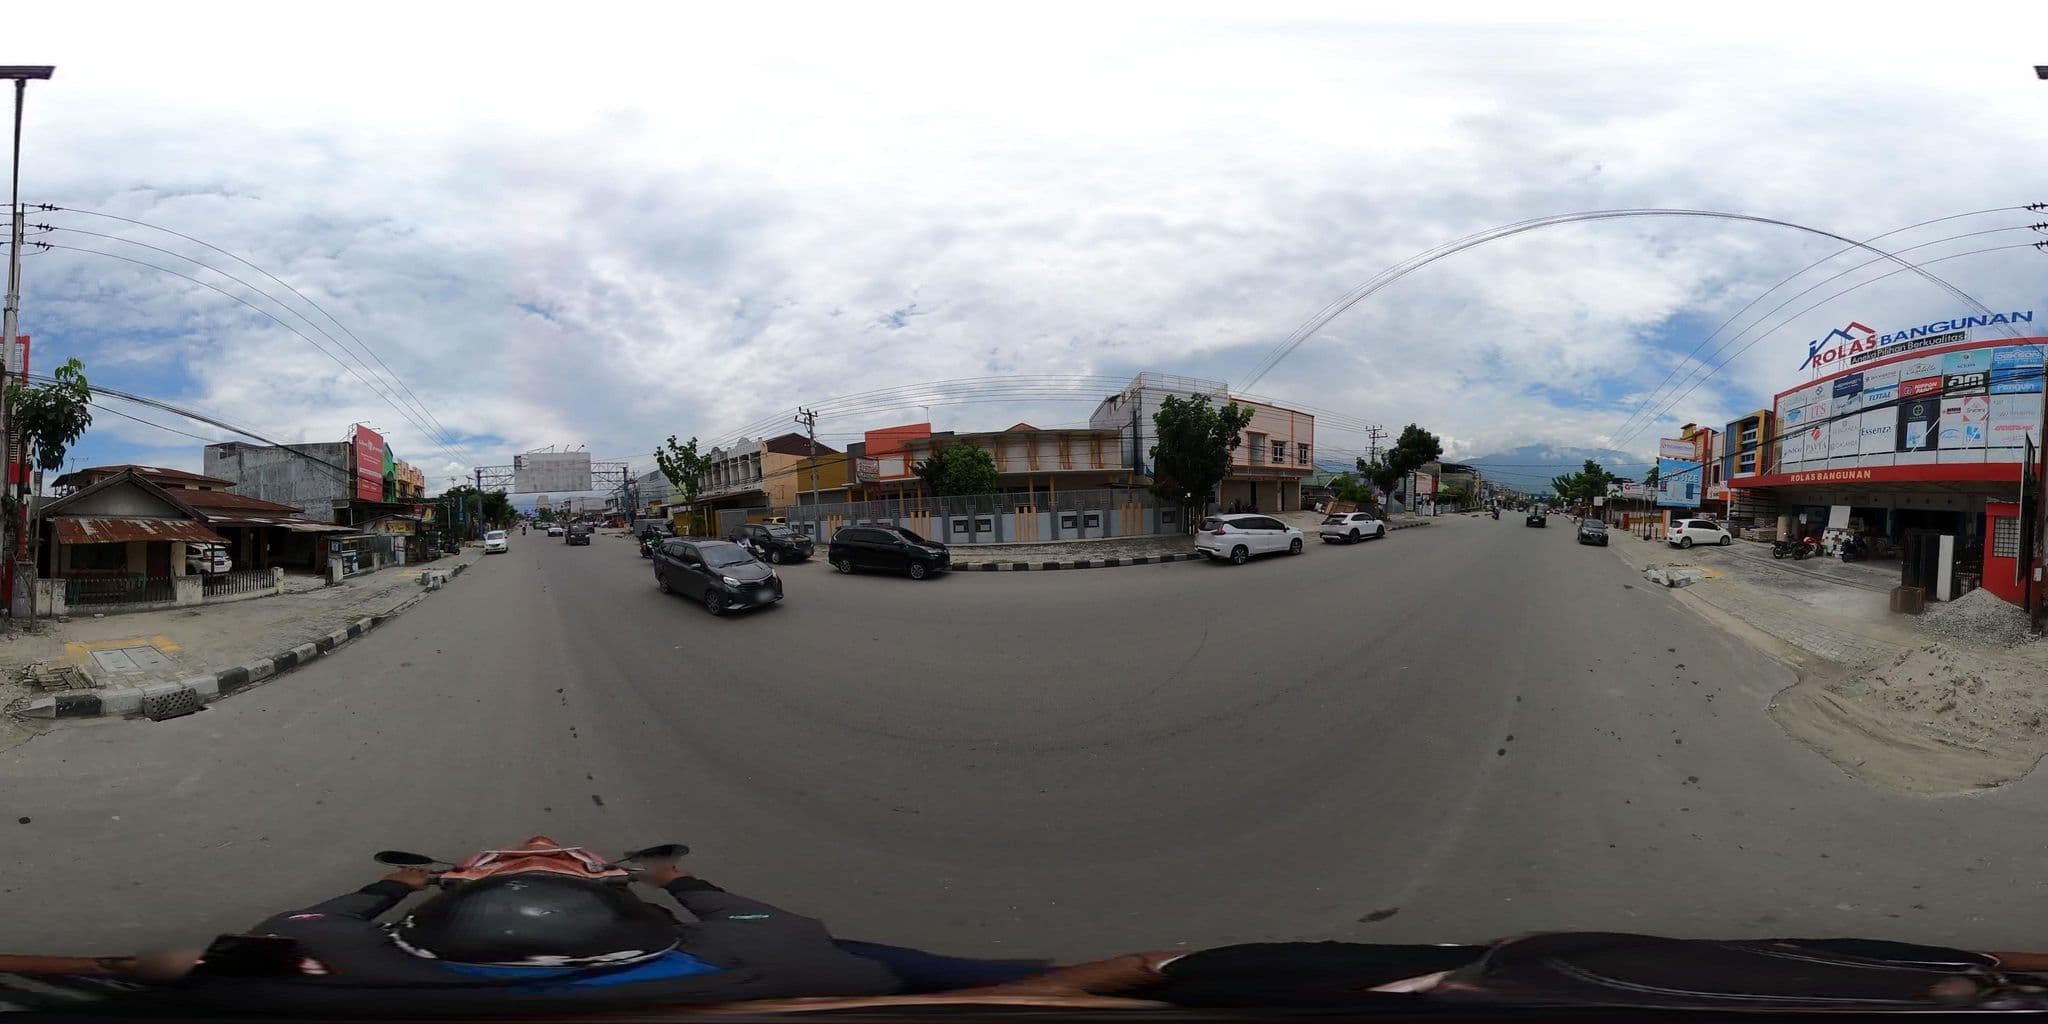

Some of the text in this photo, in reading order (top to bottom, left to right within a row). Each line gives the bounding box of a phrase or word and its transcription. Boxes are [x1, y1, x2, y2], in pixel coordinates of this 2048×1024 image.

[1812, 310, 2033, 368] ROLAS BANGUNAN
[1851, 333, 1964, 364] Aneka Pilihan Berkualitas
[1868, 391, 1891, 402] TOTAL
[1861, 426, 1892, 436] Essenza
[1790, 470, 1871, 482] ROLAS BANGUNAN
